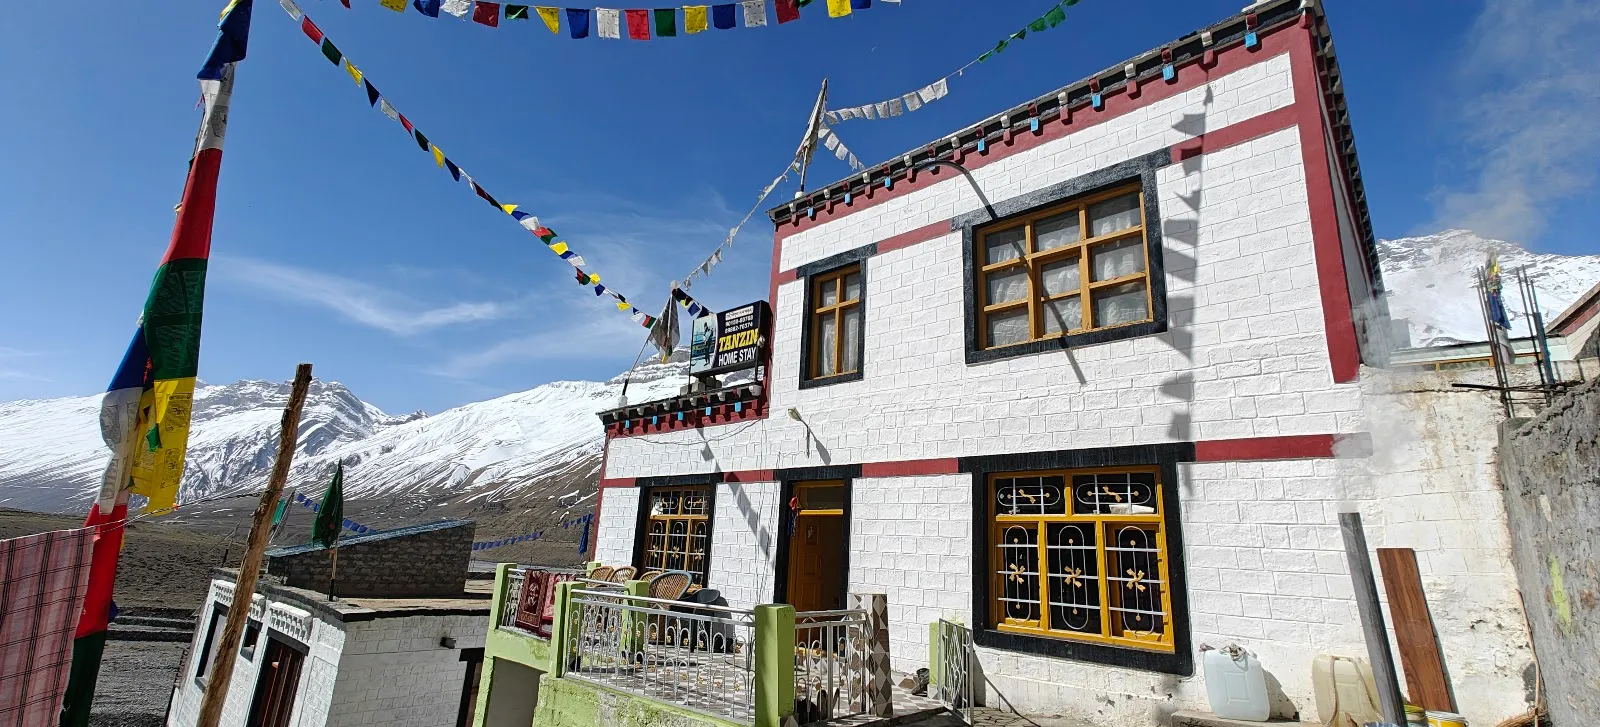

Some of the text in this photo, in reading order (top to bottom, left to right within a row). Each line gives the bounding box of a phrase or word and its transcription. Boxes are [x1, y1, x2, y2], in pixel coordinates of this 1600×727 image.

[719, 328, 758, 352] TANZIN
[718, 346, 757, 366] HOME STAY
